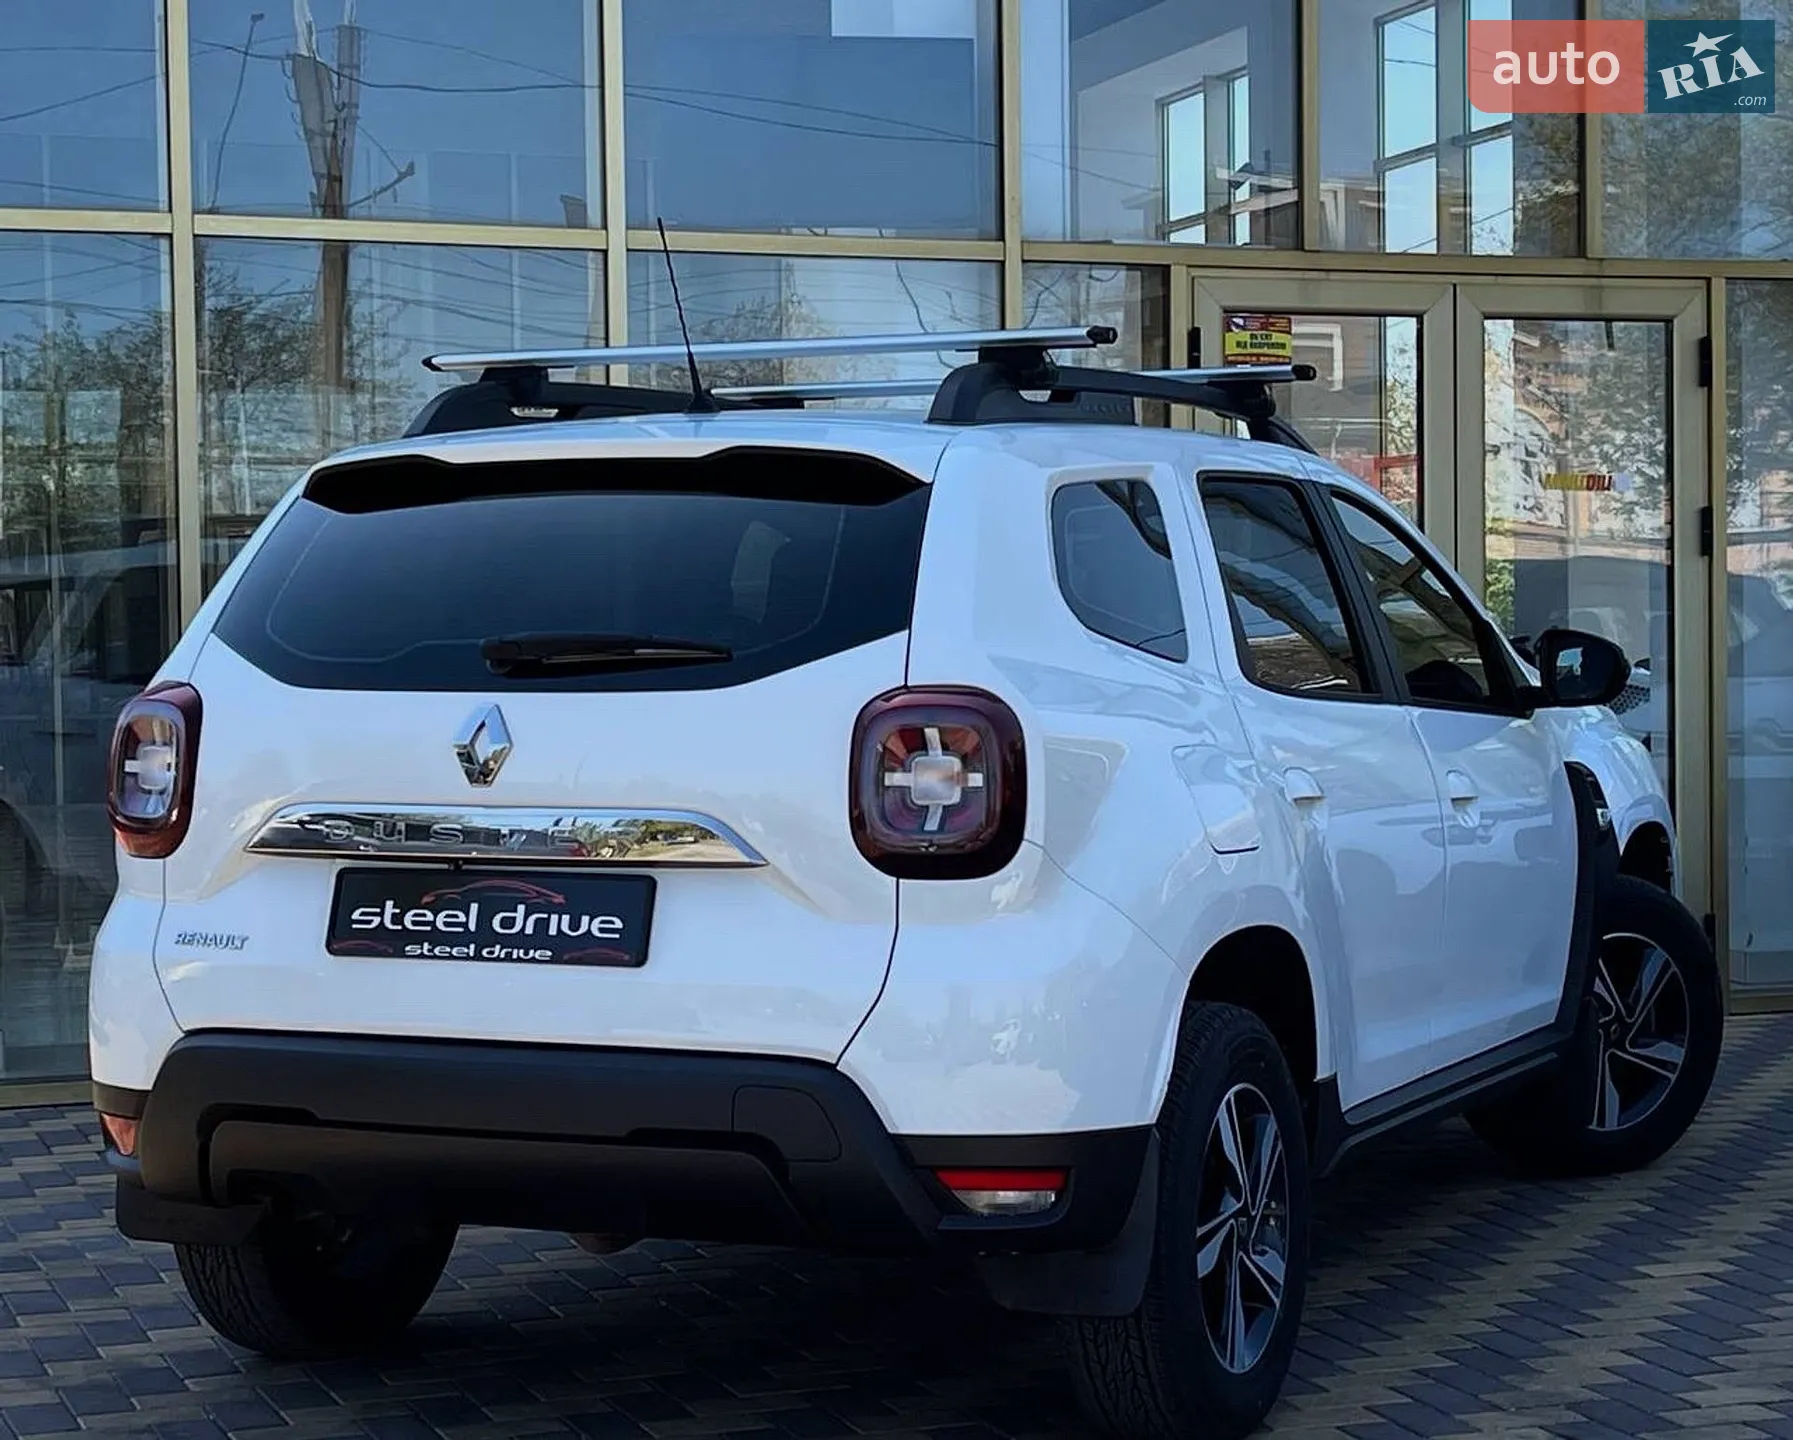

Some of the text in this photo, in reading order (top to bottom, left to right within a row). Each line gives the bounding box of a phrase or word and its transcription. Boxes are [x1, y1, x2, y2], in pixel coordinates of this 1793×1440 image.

[351, 900, 623, 938] steel drive
[174, 931, 249, 950] RENAULT
[404, 942, 553, 961] steel drive
